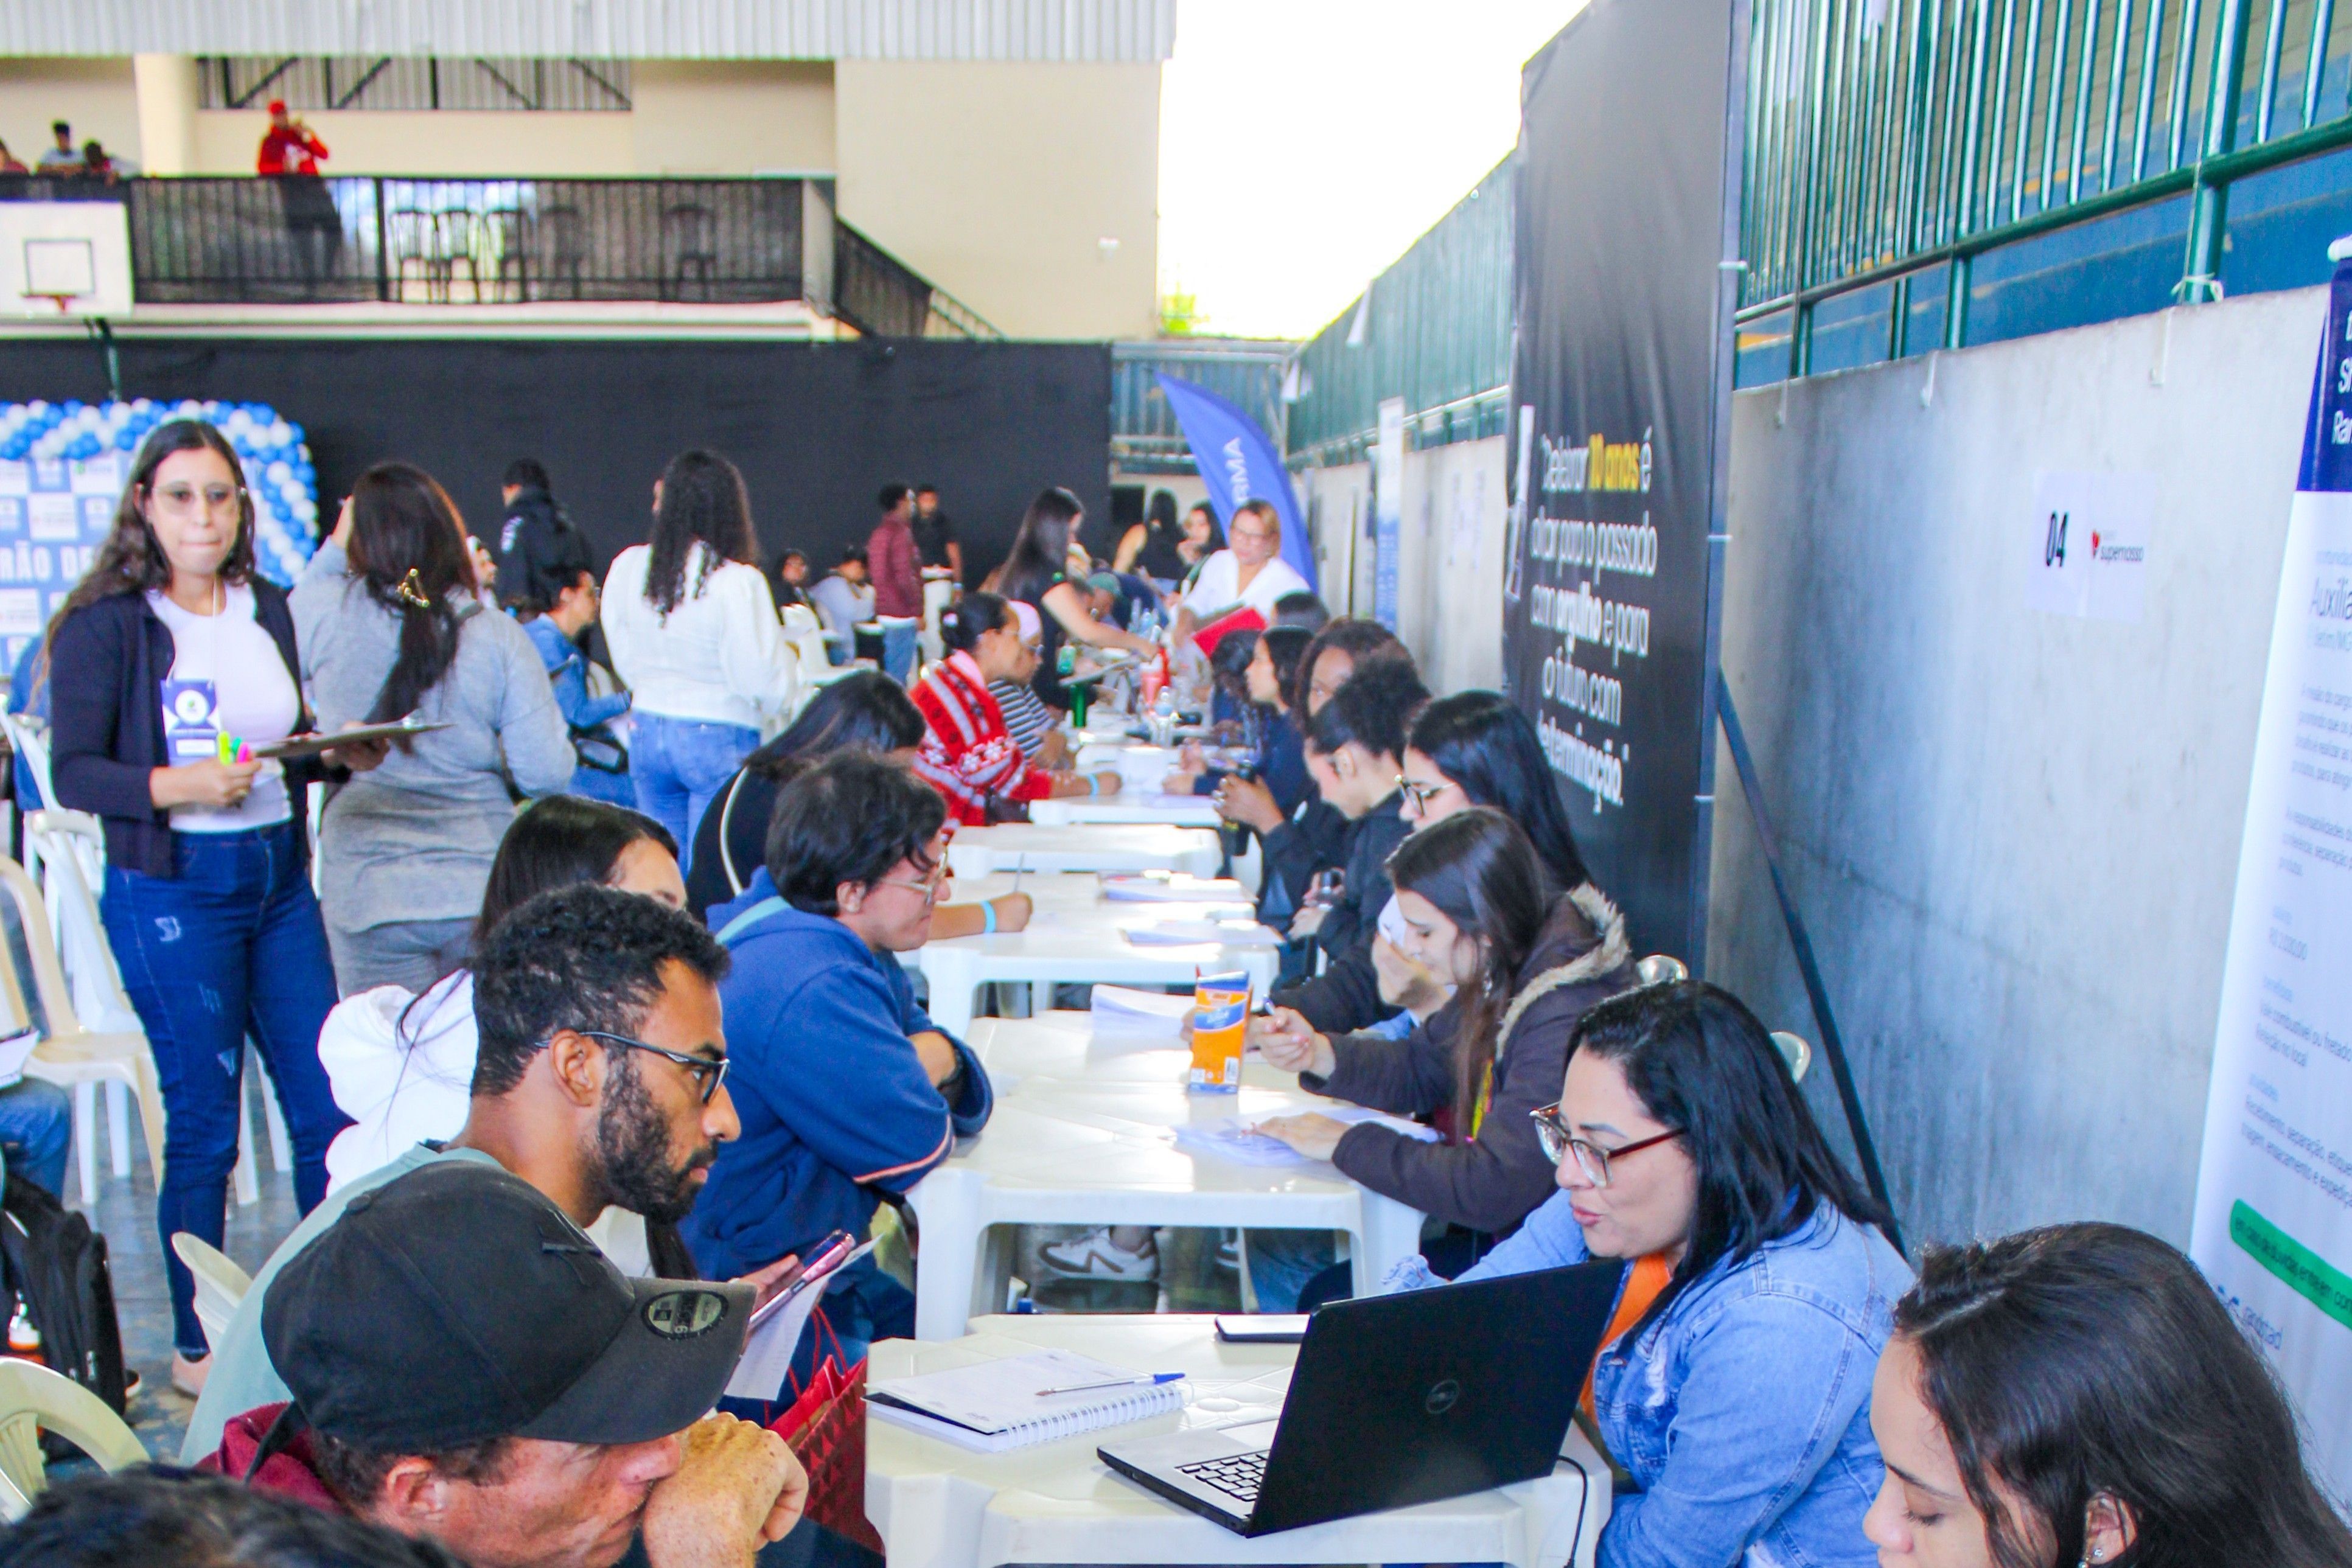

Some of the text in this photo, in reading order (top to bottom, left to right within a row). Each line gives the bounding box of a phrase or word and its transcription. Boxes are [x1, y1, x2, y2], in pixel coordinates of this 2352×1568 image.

[1589, 433, 1604, 491] 10
[1605, 442, 1640, 492] anos
[1640, 425, 1652, 493] é
[1585, 521, 1596, 566] o
[1595, 510, 1658, 585] passado
[2046, 510, 2068, 567] 04
[1530, 580, 1650, 667] com orgulho e para
[1541, 646, 1622, 727] o futuro com
